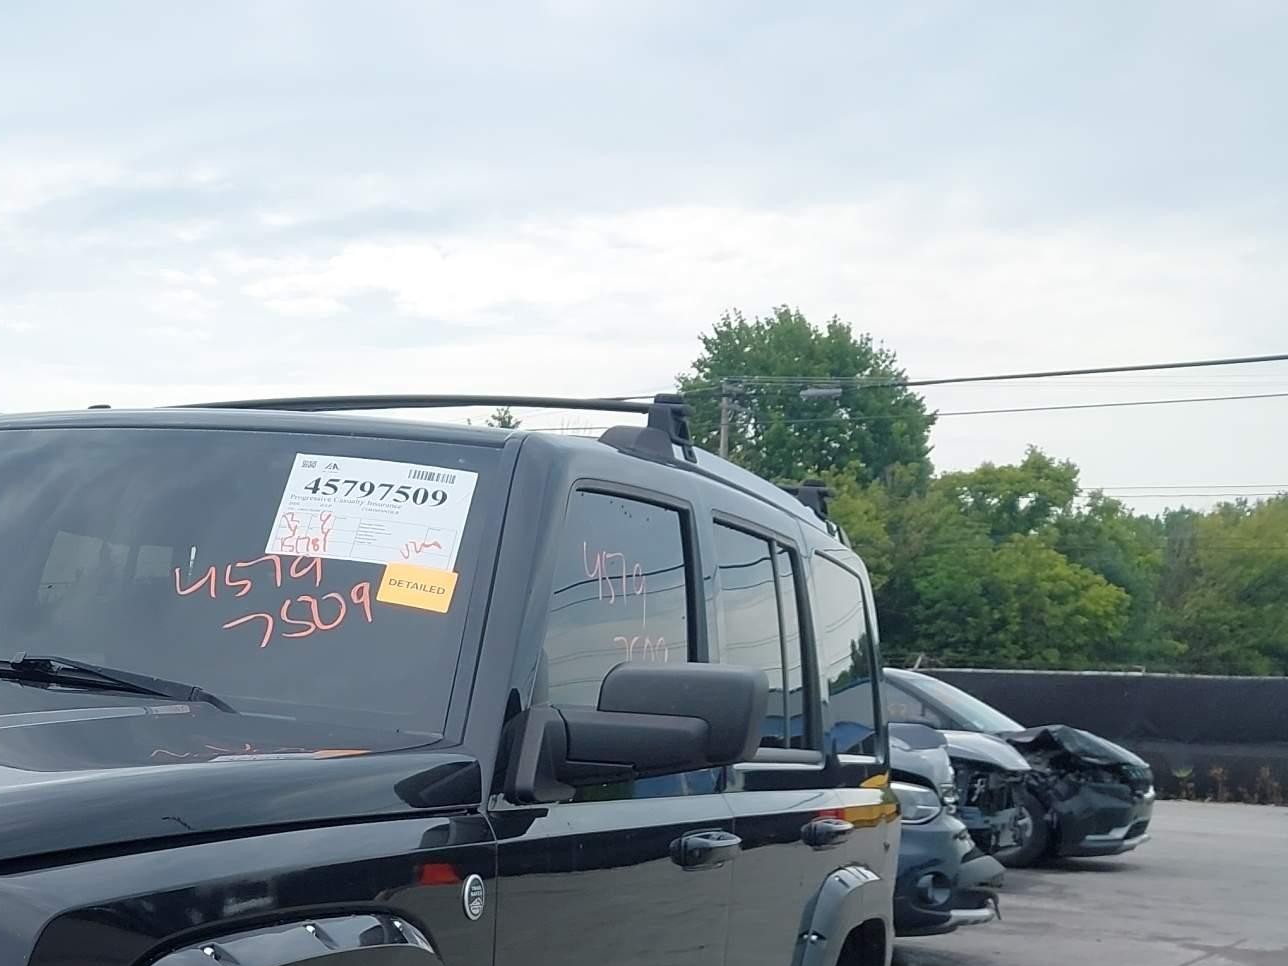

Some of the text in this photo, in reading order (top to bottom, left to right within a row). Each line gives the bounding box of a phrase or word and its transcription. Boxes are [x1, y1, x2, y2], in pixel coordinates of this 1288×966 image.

[304, 476, 448, 507] 45797509
[174, 554, 323, 599] 4579
[388, 577, 446, 596] DETAILED
[222, 581, 374, 648] 7509
